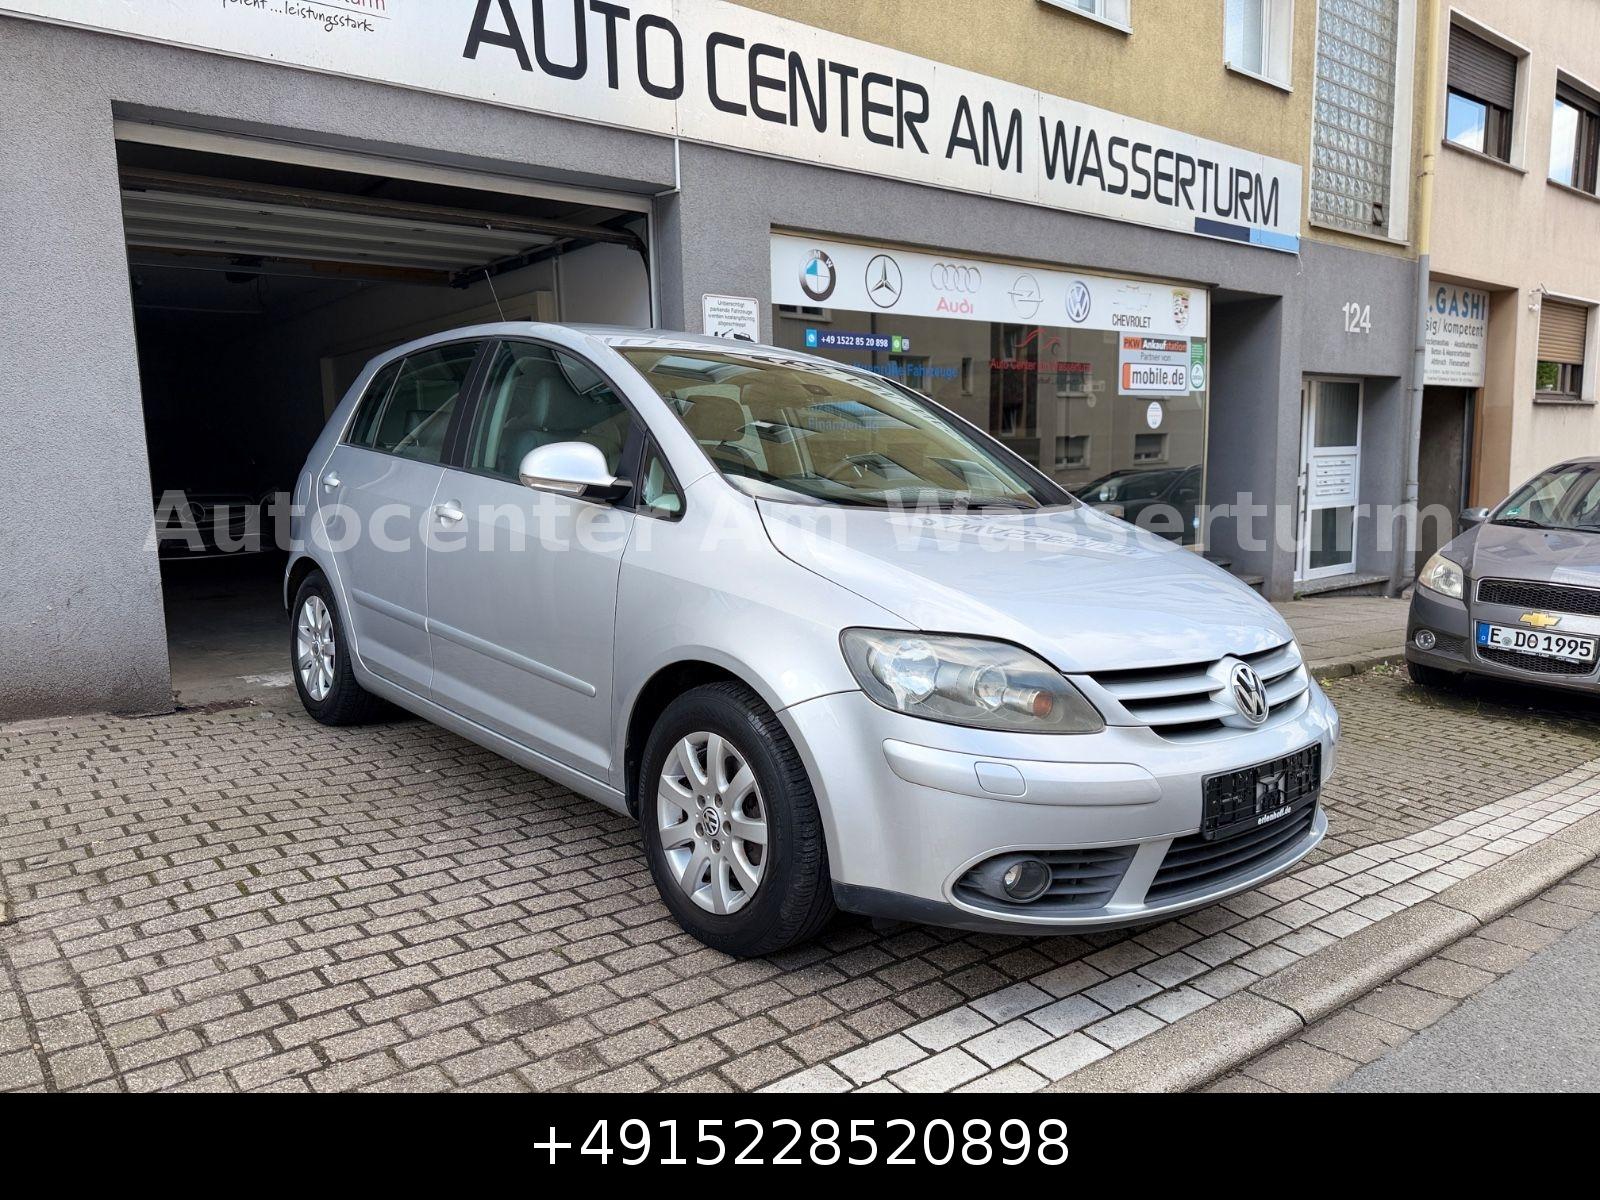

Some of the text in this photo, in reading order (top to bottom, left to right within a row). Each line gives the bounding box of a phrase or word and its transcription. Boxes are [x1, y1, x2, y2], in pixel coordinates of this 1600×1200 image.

[463, 0, 1279, 227] AUTO CENTER AM WASSERTURM
[935, 296, 974, 315] Audi
[1112, 313, 1151, 328] CHEVROLET
[1342, 302, 1371, 333] 124
[1443, 319, 1483, 337] kompetent
[821, 335, 889, 348] +49 1522 85 20 898
[1132, 367, 1184, 386] mobile.de
[1490, 627, 1502, 644] E
[1542, 636, 1592, 657] 1995
